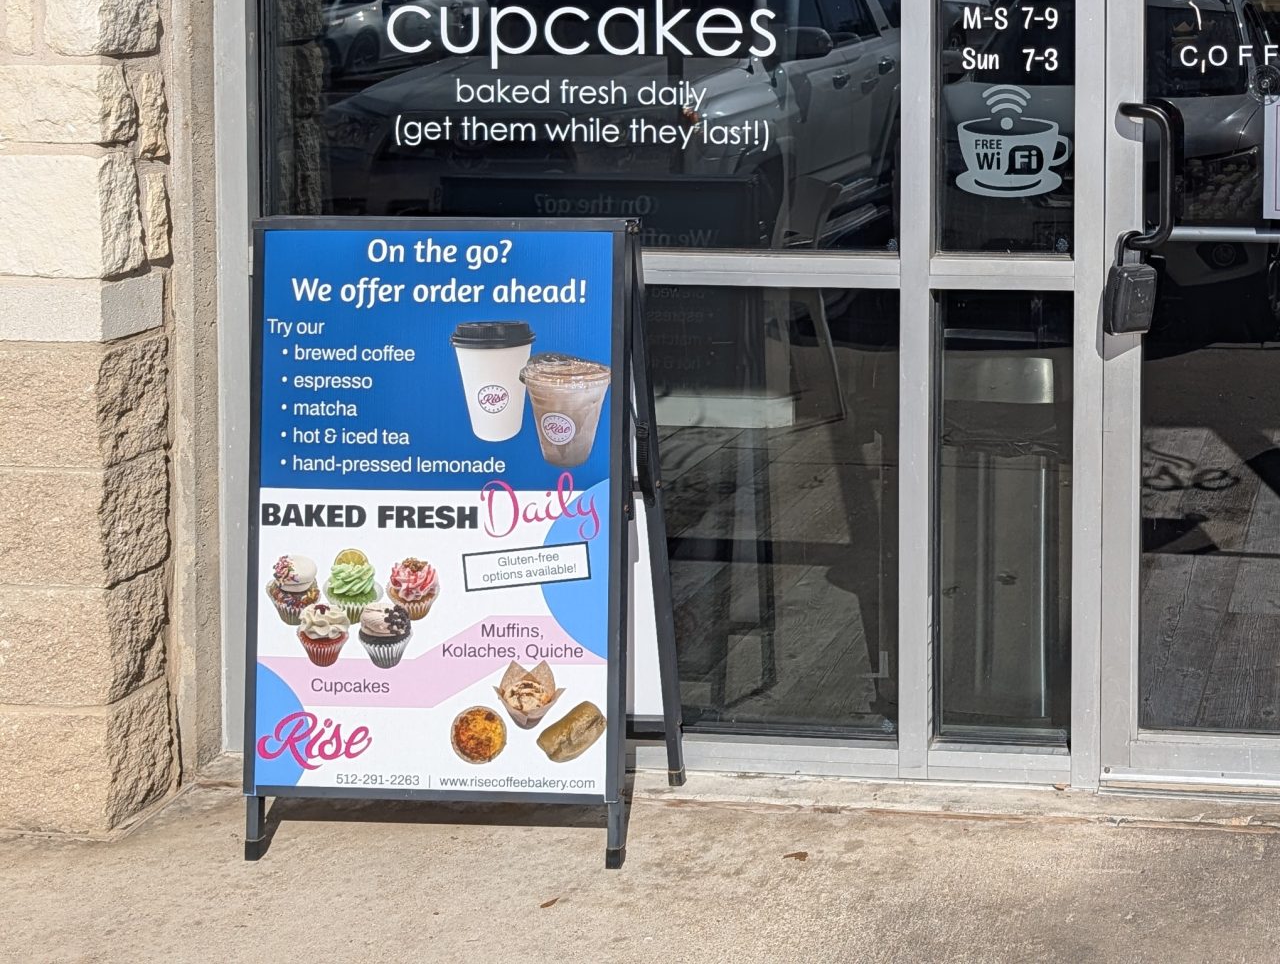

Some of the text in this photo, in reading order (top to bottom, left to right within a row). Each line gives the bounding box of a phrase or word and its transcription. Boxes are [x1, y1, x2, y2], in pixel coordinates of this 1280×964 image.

[962, 6, 1059, 30] M-S 7-9
[961, 47, 1059, 72] Sun 7-3
[455, 78, 708, 111] baked fresh daily
[395, 114, 771, 152] (get them while they last!)
[974, 139, 1003, 151] FREE
[975, 150, 1038, 171] Wi Fi
[366, 238, 514, 271] On the go?
[291, 277, 588, 310] We offer order ahead!
[266, 318, 326, 338] Try our
[293, 345, 416, 362] brewed coffee
[292, 375, 374, 393] espresso
[292, 401, 358, 417] matcha
[480, 391, 509, 407] Rise
[292, 427, 411, 446] hot & iced tea
[292, 455, 507, 477] hand-pressed lemonade
[261, 471, 602, 541] BAKED FRESH Daily
[497, 550, 560, 568] Gluten-free
[482, 562, 578, 584] options available!
[480, 623, 545, 642] Muffins,
[441, 643, 584, 661] Kolaches, Quiche
[310, 677, 391, 697] Cupcakes
[256, 711, 373, 771] Rise
[335, 773, 596, 790] 512-291-2263 www.risecoffeebakery.com
